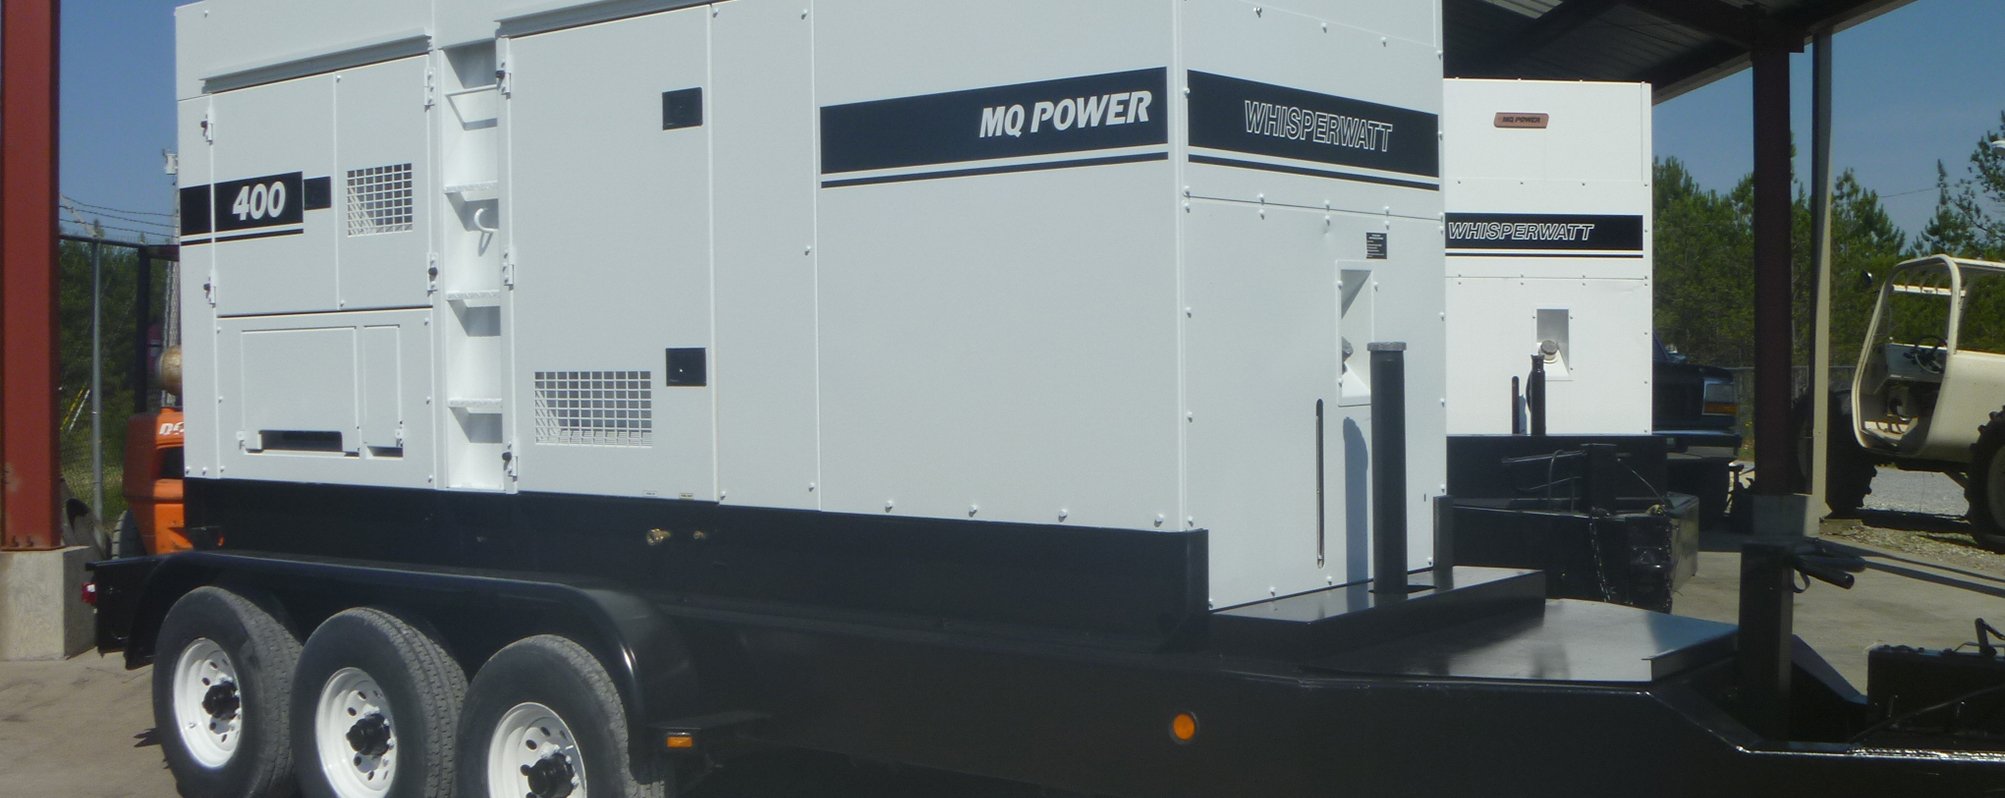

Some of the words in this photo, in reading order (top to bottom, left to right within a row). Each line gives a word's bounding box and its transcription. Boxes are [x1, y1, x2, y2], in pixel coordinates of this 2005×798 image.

[979, 104, 1025, 138] MQ
[1030, 90, 1152, 133] POWER
[1244, 99, 1393, 153] WHISPERWATT
[232, 181, 286, 221] 400
[1448, 221, 1595, 241] WHISPERWATT
